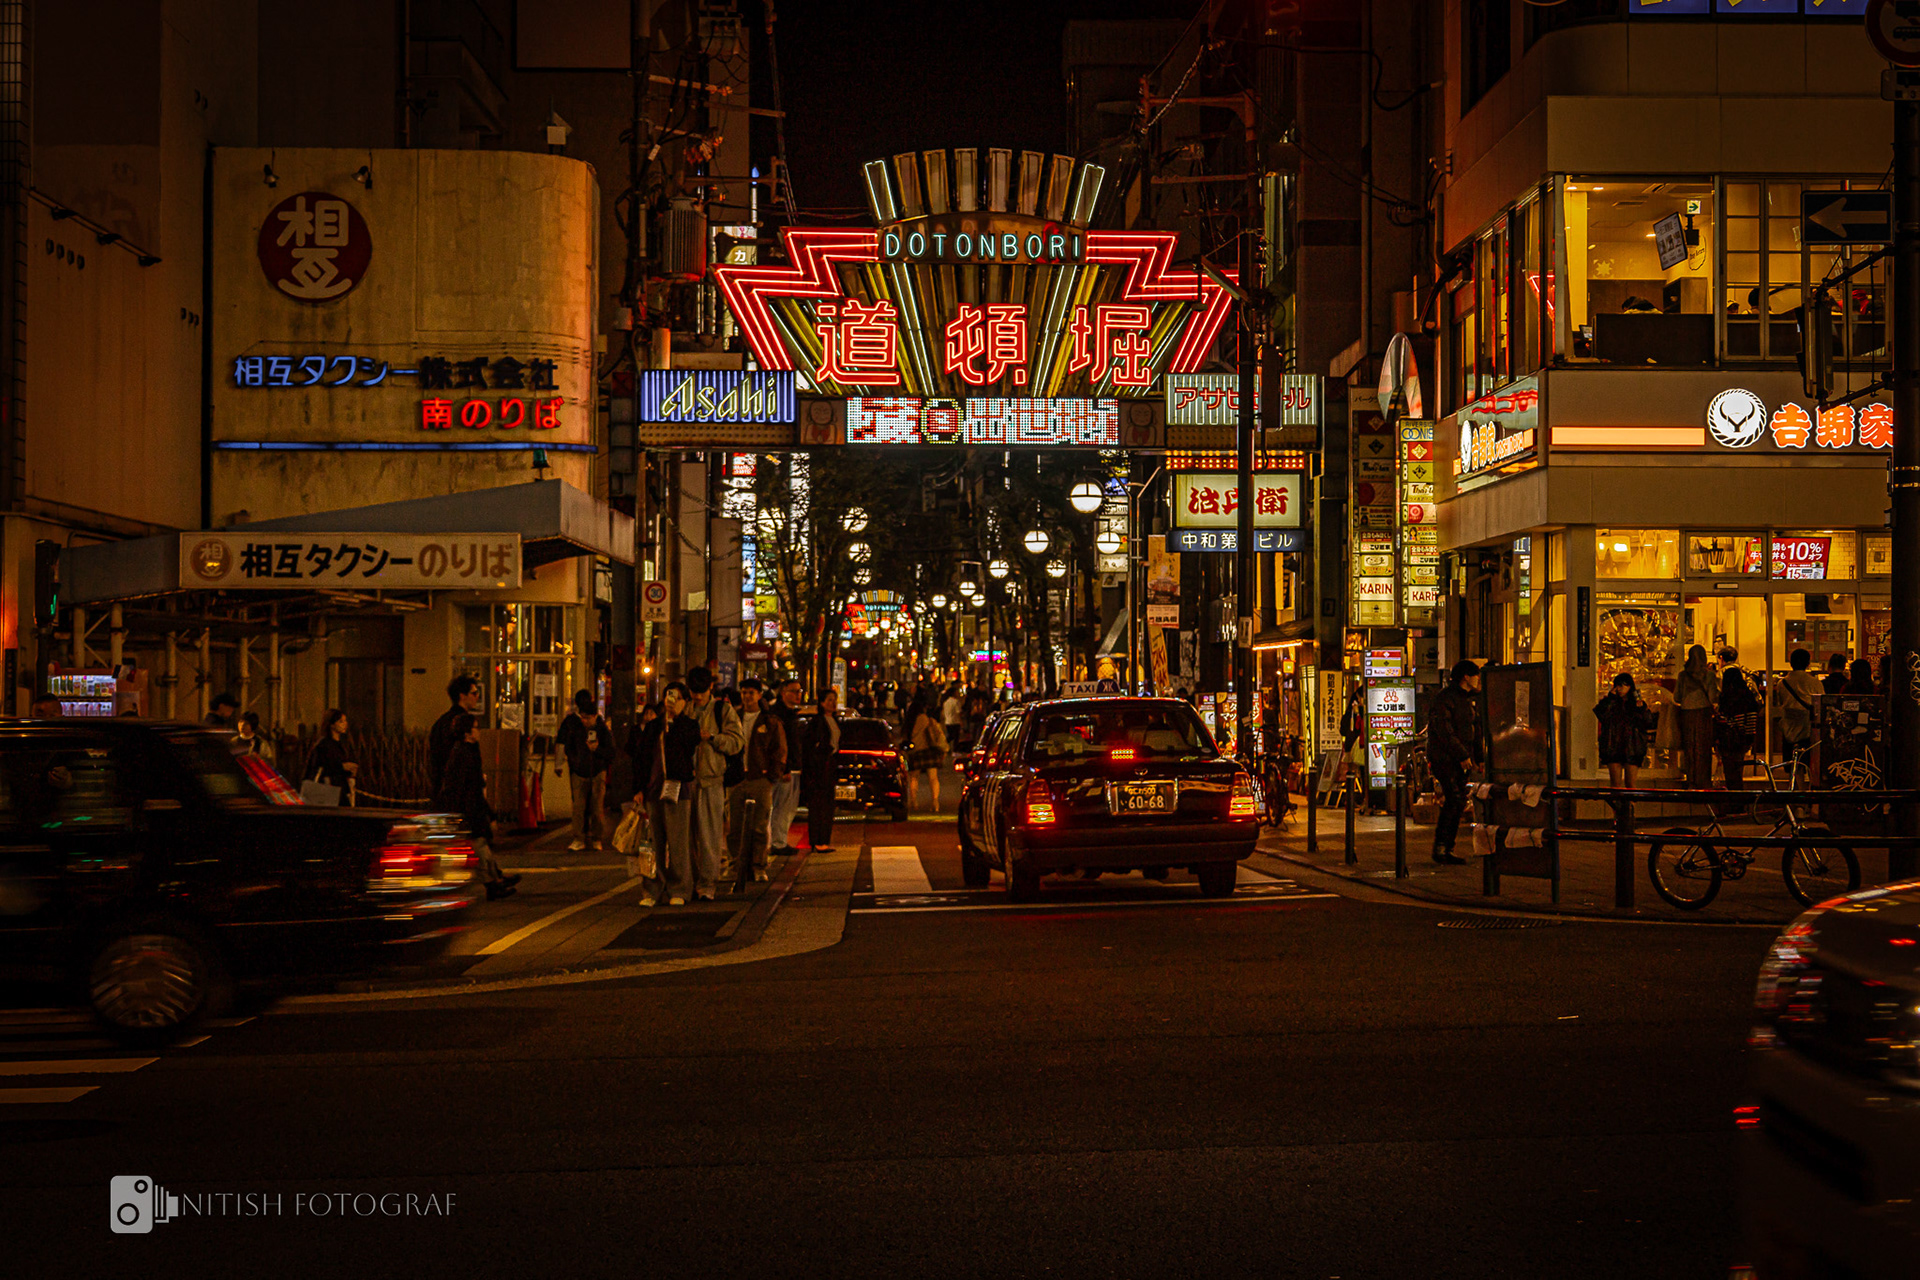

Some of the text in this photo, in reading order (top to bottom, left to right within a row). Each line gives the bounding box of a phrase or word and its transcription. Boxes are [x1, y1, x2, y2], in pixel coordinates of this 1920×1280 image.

[884, 232, 1080, 258] DOTONBORI
[815, 298, 1152, 387] 道頓堀
[233, 354, 560, 391] 相互タクシー株式会社
[660, 372, 778, 419] Asahi
[421, 396, 565, 430] 南のりば
[1770, 402, 1894, 449] 吉野家
[1182, 533, 1293, 549] 中和第ビル
[1788, 542, 1822, 561] 10%
[241, 543, 513, 578] 相互タクシーのりば
[1360, 583, 1393, 594] KARIN
[1069, 684, 1095, 693] TAXI
[1128, 795, 1164, 809] 60-68
